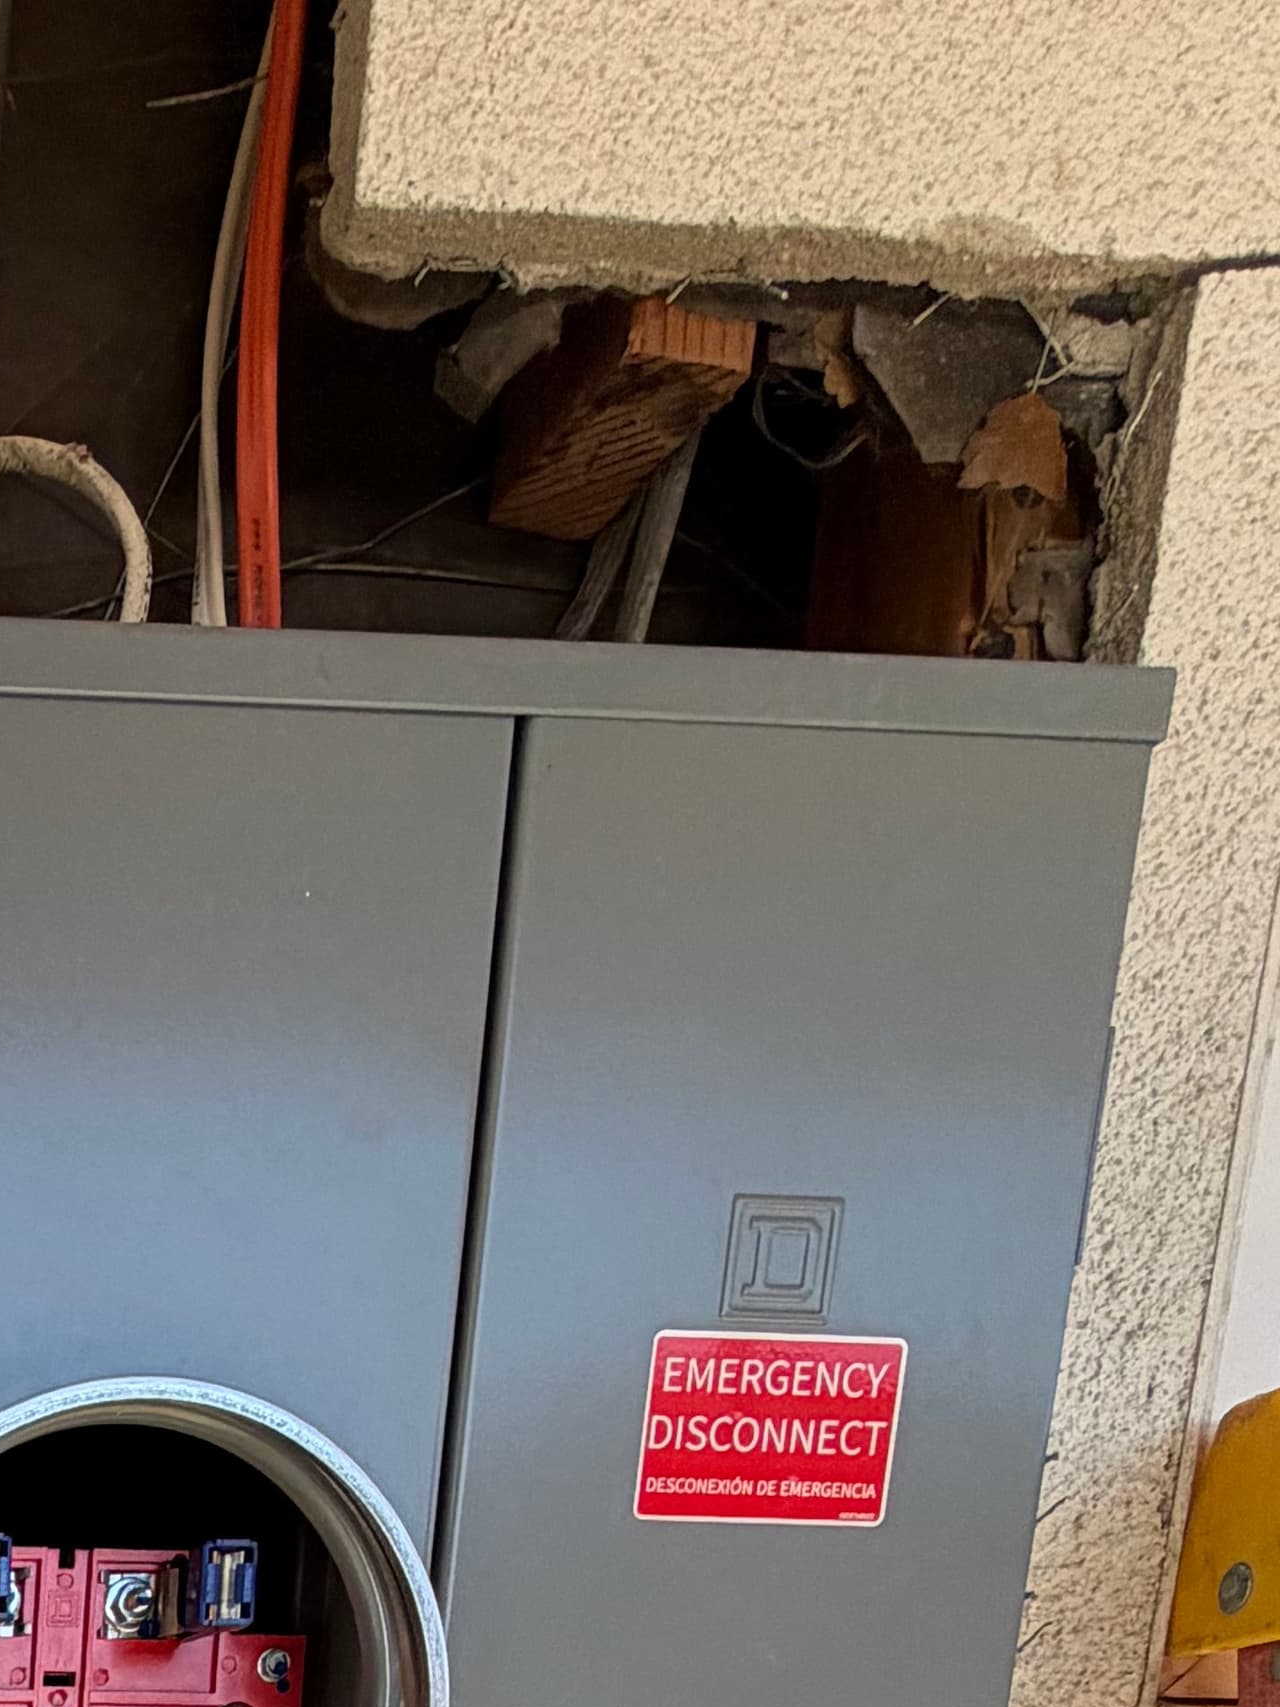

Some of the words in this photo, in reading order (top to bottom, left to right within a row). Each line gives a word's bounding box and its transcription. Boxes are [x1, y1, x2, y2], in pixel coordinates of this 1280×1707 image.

[661, 1356, 893, 1399] EMERGENCY
[646, 1414, 889, 1457] DISCONNECT
[645, 1475, 753, 1496] DESCONEXIÓN
[756, 1480, 778, 1497] DE
[780, 1480, 877, 1499] EMERGENCIA
